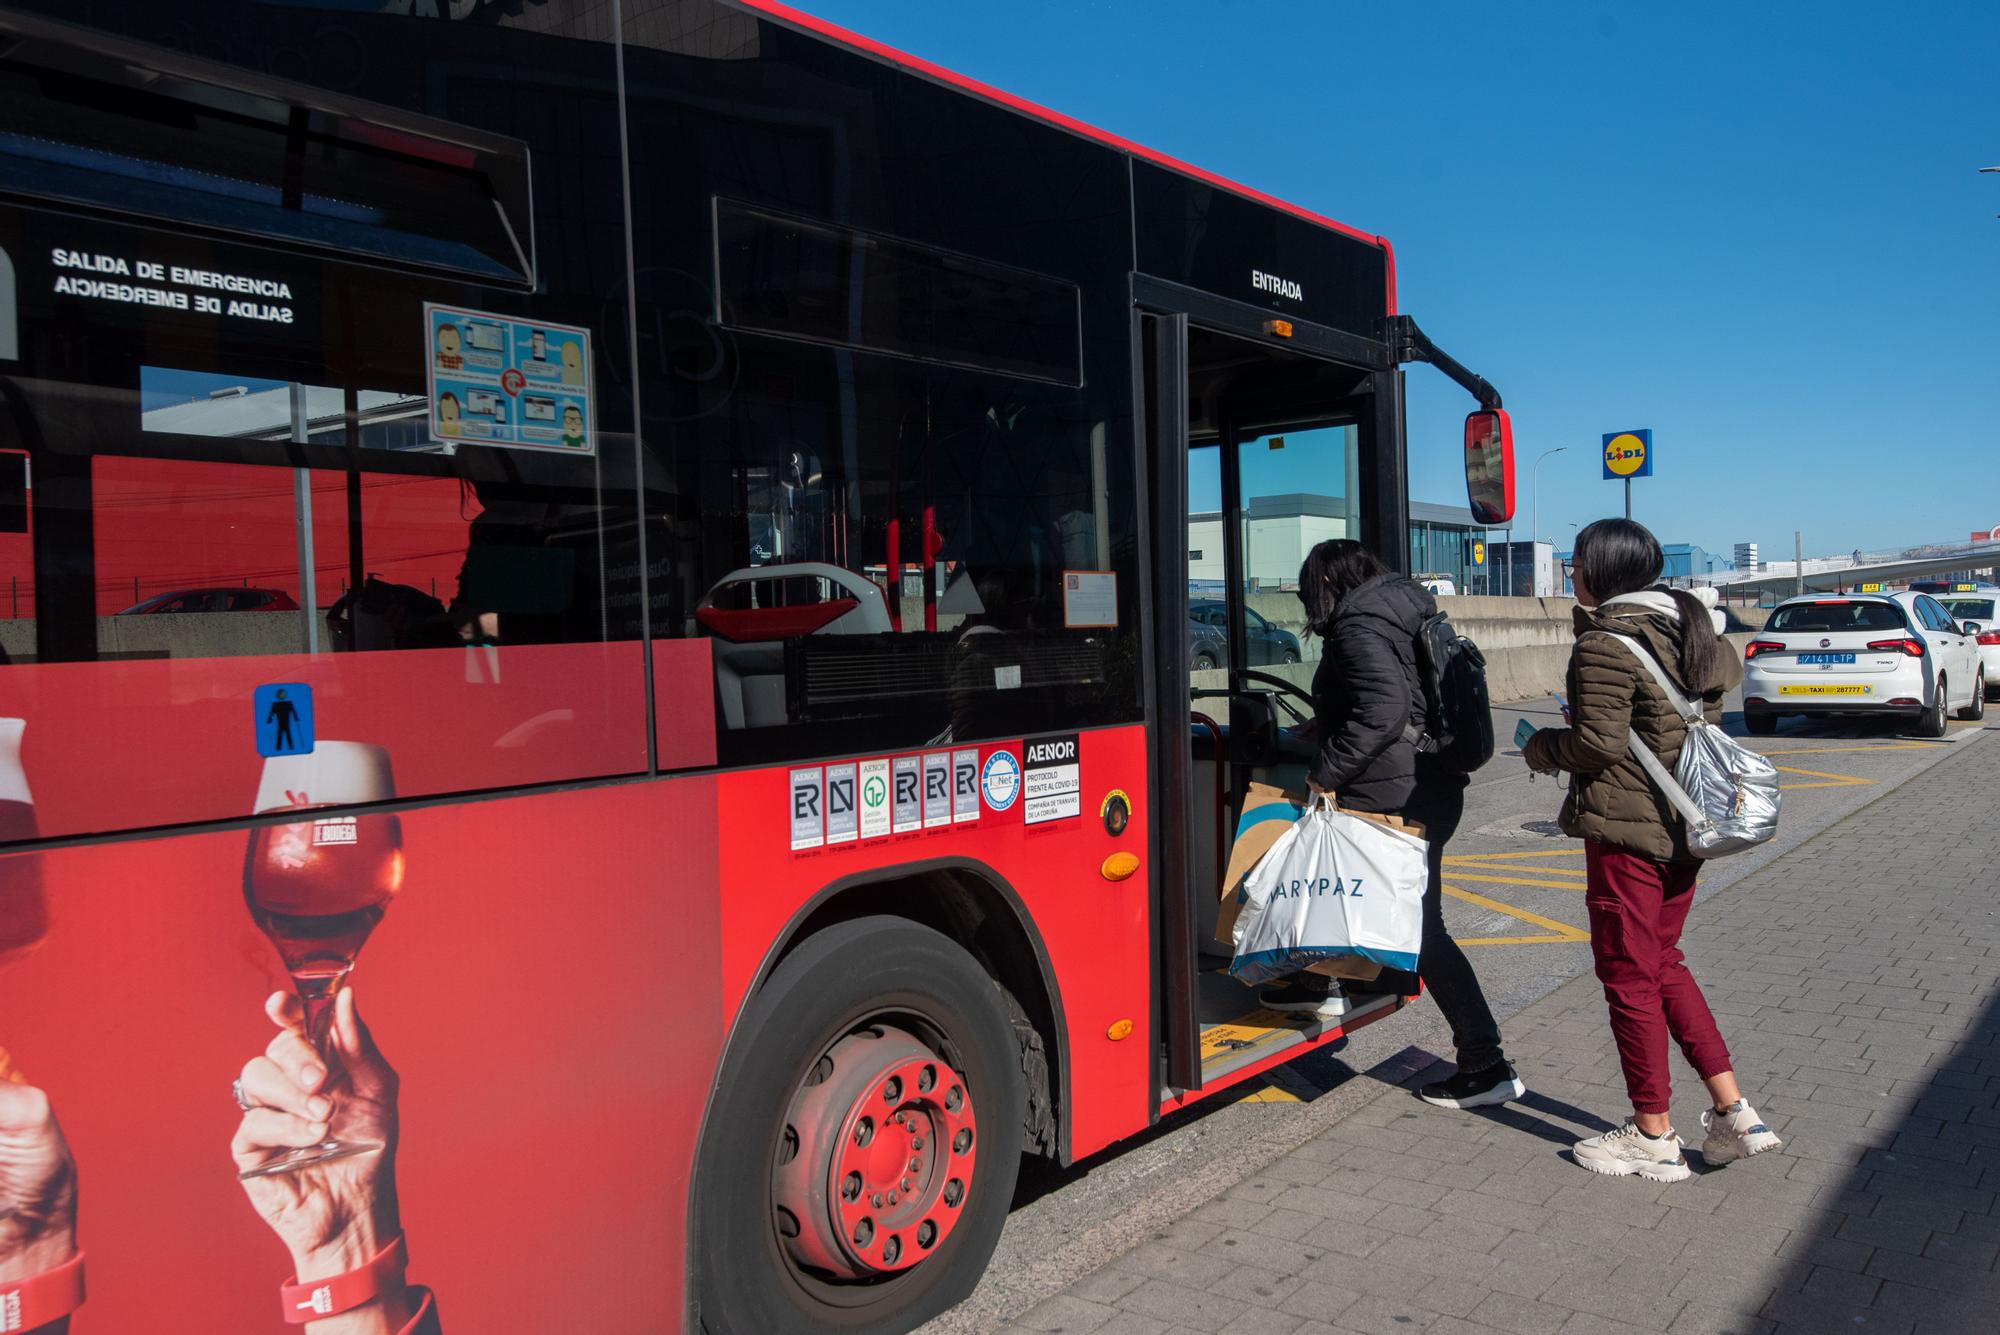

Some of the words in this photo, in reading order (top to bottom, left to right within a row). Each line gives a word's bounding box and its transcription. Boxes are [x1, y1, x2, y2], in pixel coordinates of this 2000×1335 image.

[52, 248, 130, 276] SALIDA
[135, 261, 165, 281] DE
[171, 266, 292, 299] EMERGENCIA
[1252, 269, 1303, 301] ENTRADA
[1606, 447, 1643, 461] LIDL
[1803, 654, 1829, 663] 7141
[1833, 654, 1853, 663] LTP
[1027, 741, 1075, 763] AENOR
[864, 764, 886, 773] AENOR
[1027, 771, 1058, 782] PROTOCOLO
[1027, 784, 1047, 793] FRENTE
[1055, 779, 1078, 789] COVID-19
[322, 824, 357, 841] BODEGA
